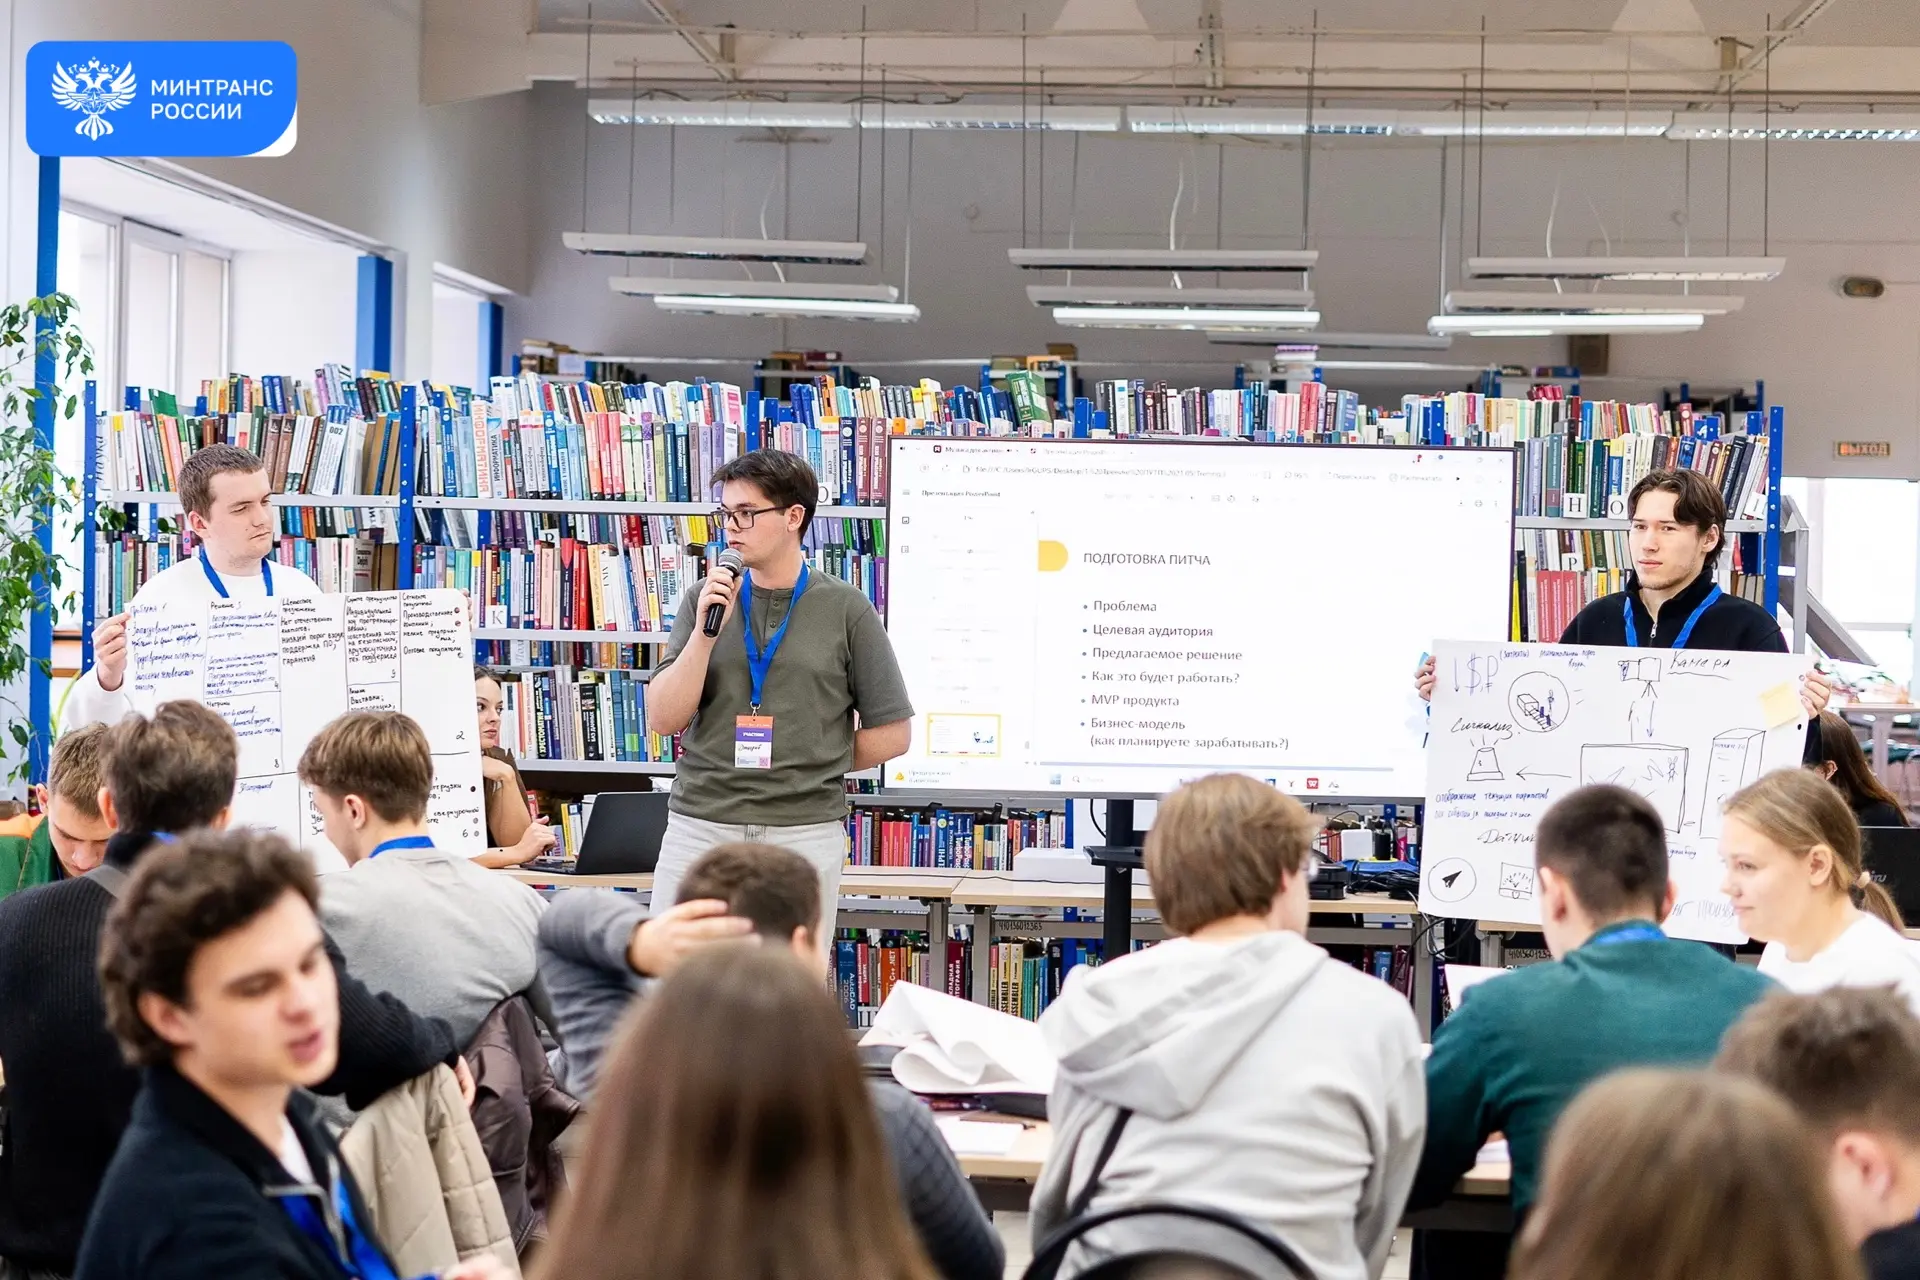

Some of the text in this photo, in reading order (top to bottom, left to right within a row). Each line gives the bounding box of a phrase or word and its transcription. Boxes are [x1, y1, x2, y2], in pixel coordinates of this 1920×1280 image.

[329, 426, 343, 435] 002
[474, 404, 490, 493] ИНФОРМАТИКА
[490, 434, 501, 482] ИНФОРМАТИКА
[1084, 553, 1211, 565] ПОДГОТОВКА ПИТЧА
[661, 570, 669, 605] Аппаратные
[669, 570, 677, 595] средства
[1093, 600, 1157, 613] Проблема
[1093, 624, 1213, 638] Целевая аудитория
[1092, 647, 1243, 661] Предлагаемое решение
[1092, 671, 1240, 685] Как это будет работать?
[1091, 694, 1180, 708] MVP продукта
[537, 712, 546, 753] ХРЕСТОМАТИЯ
[1091, 717, 1186, 730] Бизнес-модель
[1090, 735, 1290, 750] (как планируете зарабатывать?)
[955, 836, 963, 869] TurboPasc
[964, 836, 972, 869] TurboPasc
[1001, 981, 1009, 1013] SSEMBLER
[1011, 982, 1019, 1017] SSEMBLER
